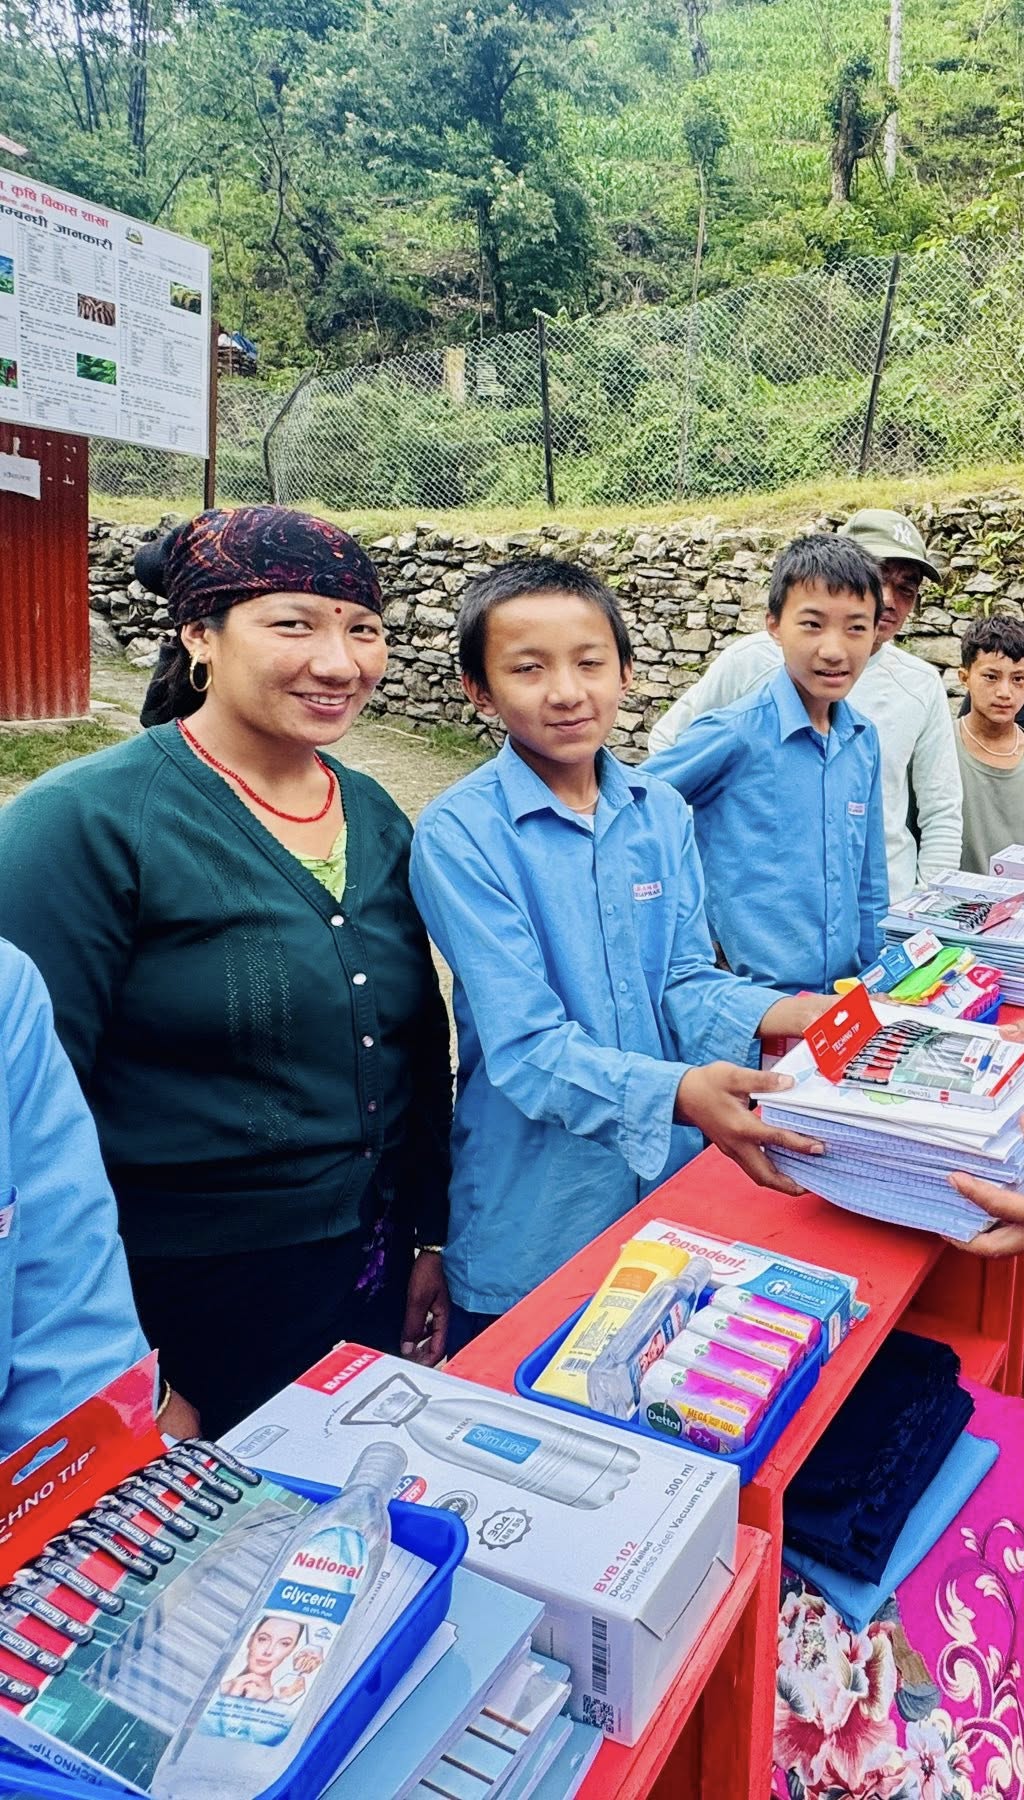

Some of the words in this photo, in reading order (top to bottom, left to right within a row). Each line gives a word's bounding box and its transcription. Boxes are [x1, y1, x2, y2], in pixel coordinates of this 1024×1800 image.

[11, 184, 37, 202] कृषि
[41, 194, 78, 217] विकास
[80, 210, 109, 229] शाखा
[53, 222, 113, 251] जानकारी
[658, 1230, 746, 1270] Pepsodent
[323, 1353, 376, 1391] BALTRA
[446, 1417, 473, 1442] BALTRA
[647, 1409, 682, 1432] Dettol
[687, 1408, 709, 1426] MEGA
[664, 1478, 684, 1497] 500
[681, 1464, 694, 1478] ml
[0, 1481, 55, 1534] CHNO
[121, 1521, 149, 1543] TECHNO
[488, 1516, 511, 1537] 304
[620, 1555, 658, 1602] Stainless
[652, 1531, 676, 1556] Steel
[669, 1494, 700, 1530] Vacuum
[695, 1471, 717, 1494] Flask
[54, 1563, 67, 1576] TIP
[293, 1551, 364, 1580] National
[593, 1565, 619, 1593] BVB
[616, 1541, 638, 1562] 102
[609, 1568, 634, 1598] Double
[630, 1541, 654, 1567] Walled
[66, 1572, 94, 1594] TECHNO
[23, 1593, 36, 1607] TIP
[281, 1585, 337, 1610] Glycerin
[35, 1602, 64, 1624] TECHNO
[2, 1634, 34, 1657] TECHNO
